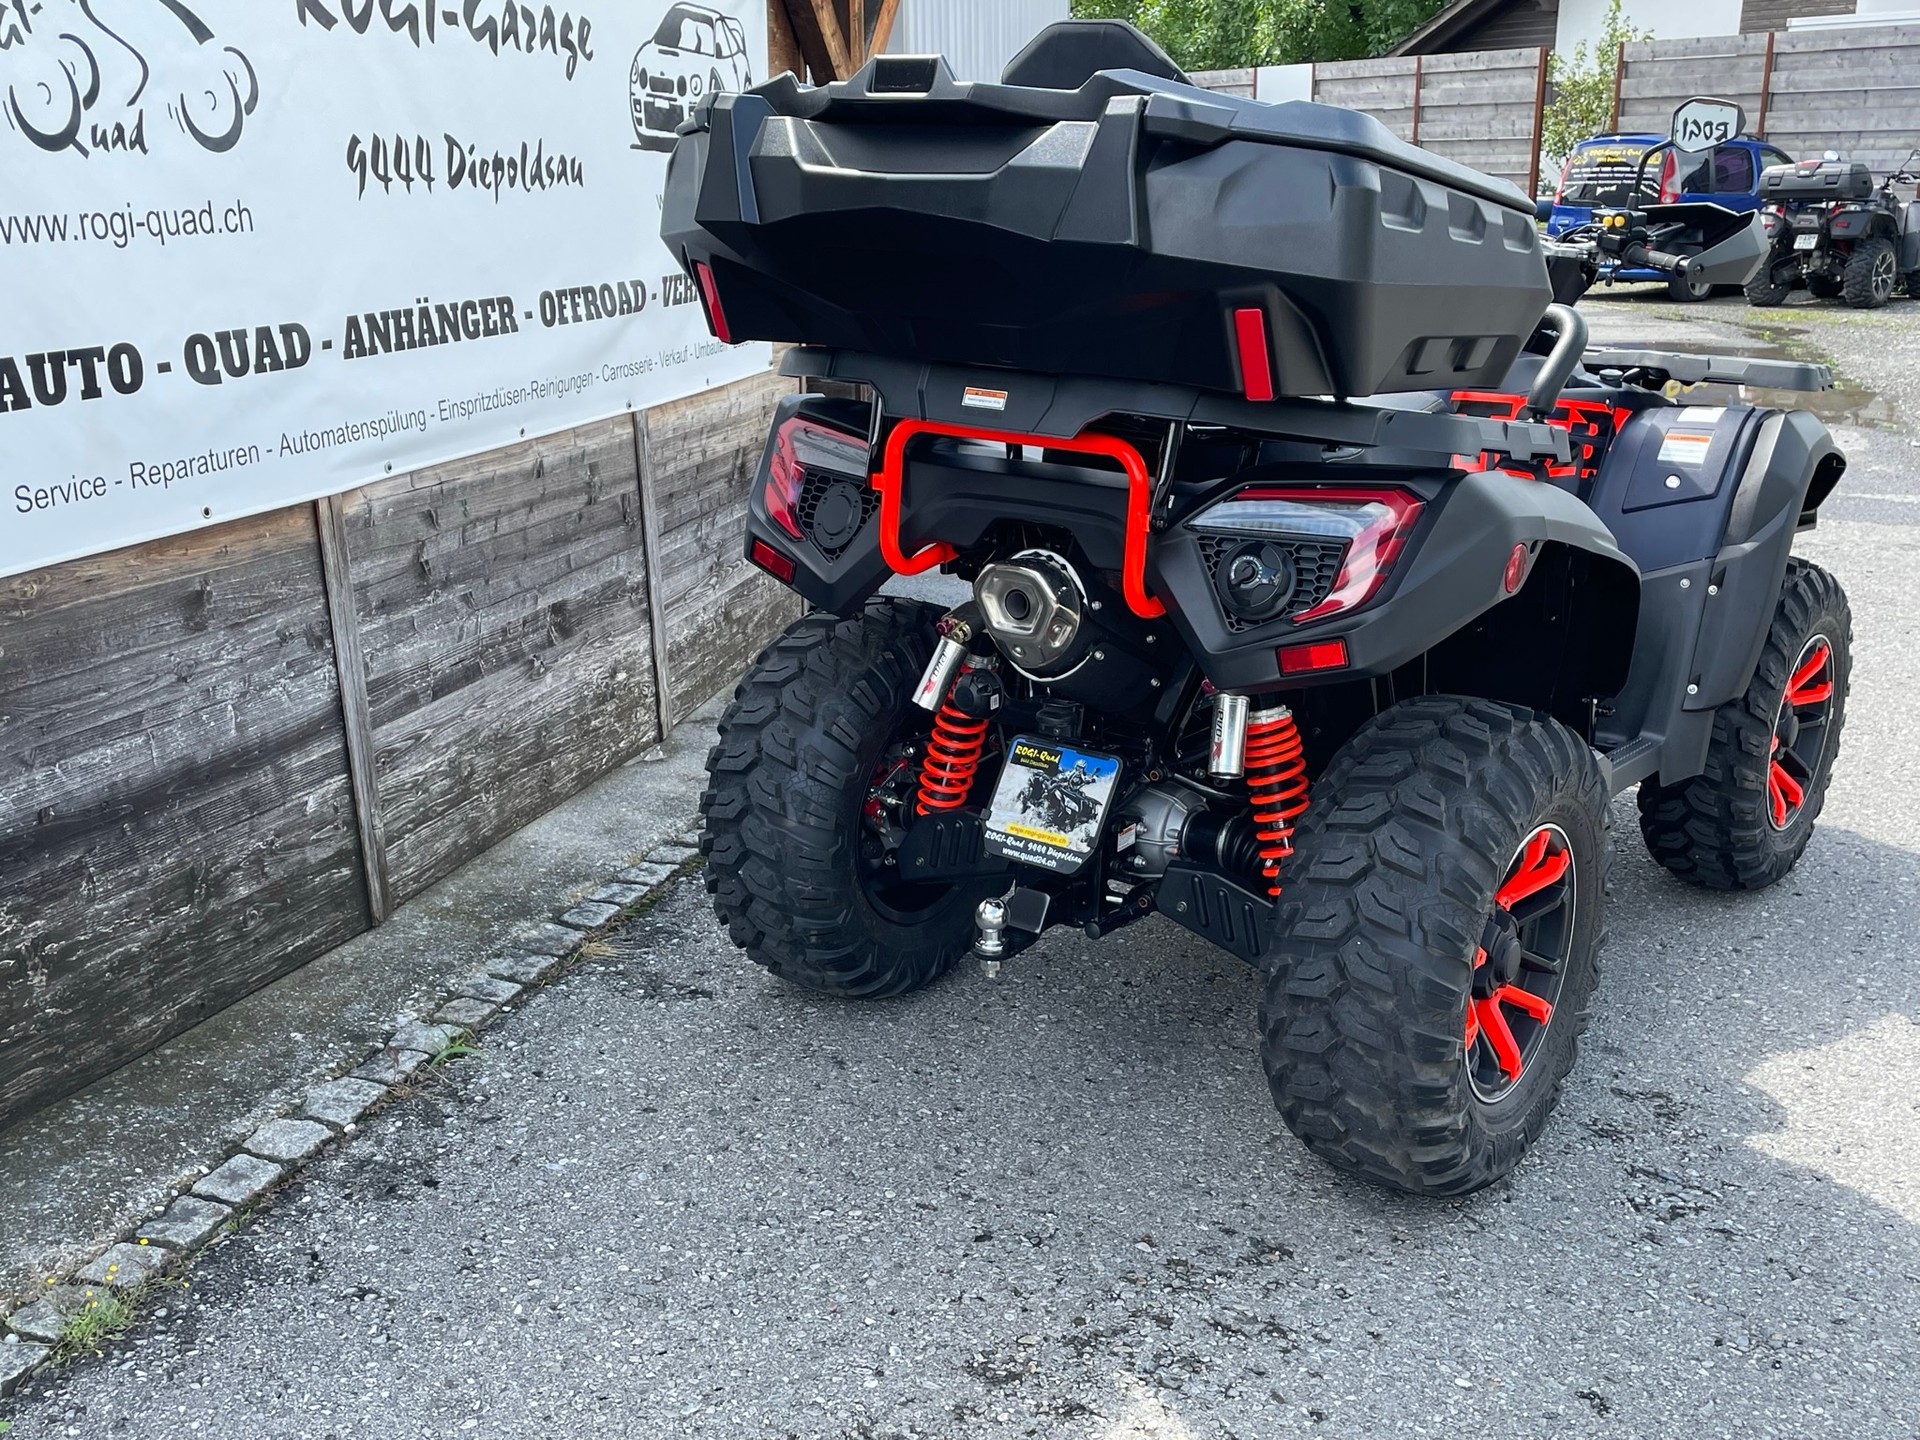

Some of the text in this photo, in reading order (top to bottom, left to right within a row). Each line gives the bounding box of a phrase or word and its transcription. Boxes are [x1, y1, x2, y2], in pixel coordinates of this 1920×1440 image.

[346, 133, 584, 204] 9444 Diepoldsau
[0, 342, 145, 412] AUTO
[183, 322, 312, 386] QUAD
[343, 296, 519, 359] ANHÄNGER
[539, 279, 647, 328] OFFROAD
[14, 475, 107, 514] Service
[129, 444, 260, 489] Reparaturen
[279, 406, 427, 458] Automatenspülung
[438, 372, 593, 421] Einspritzdüsen-Reinigungen
[601, 354, 653, 382] Carrosserie
[658, 344, 689, 368] Verkauf
[1014, 745, 1061, 764] ROGI-Quad
[984, 830, 1026, 849] ROGI-Quad
[1002, 847, 1057, 868] www.quad24.ch
